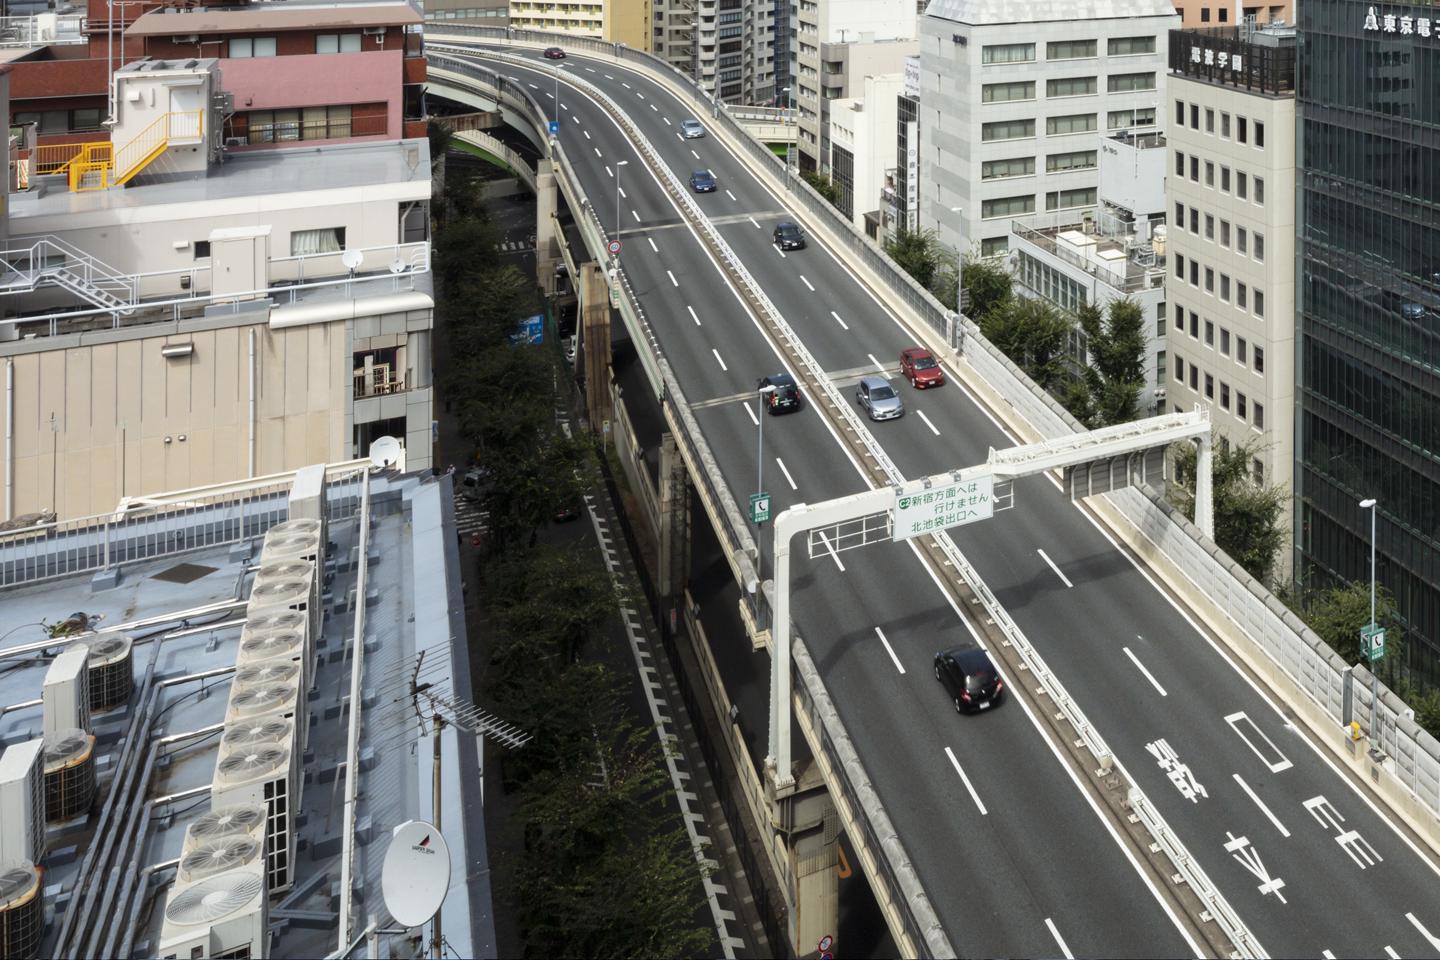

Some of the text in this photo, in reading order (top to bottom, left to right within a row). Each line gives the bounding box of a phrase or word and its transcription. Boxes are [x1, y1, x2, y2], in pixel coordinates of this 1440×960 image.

[911, 482, 977, 507] 新宿方面へは
[934, 493, 989, 514] 行けません
[911, 509, 978, 533] 北池袋出口へ
